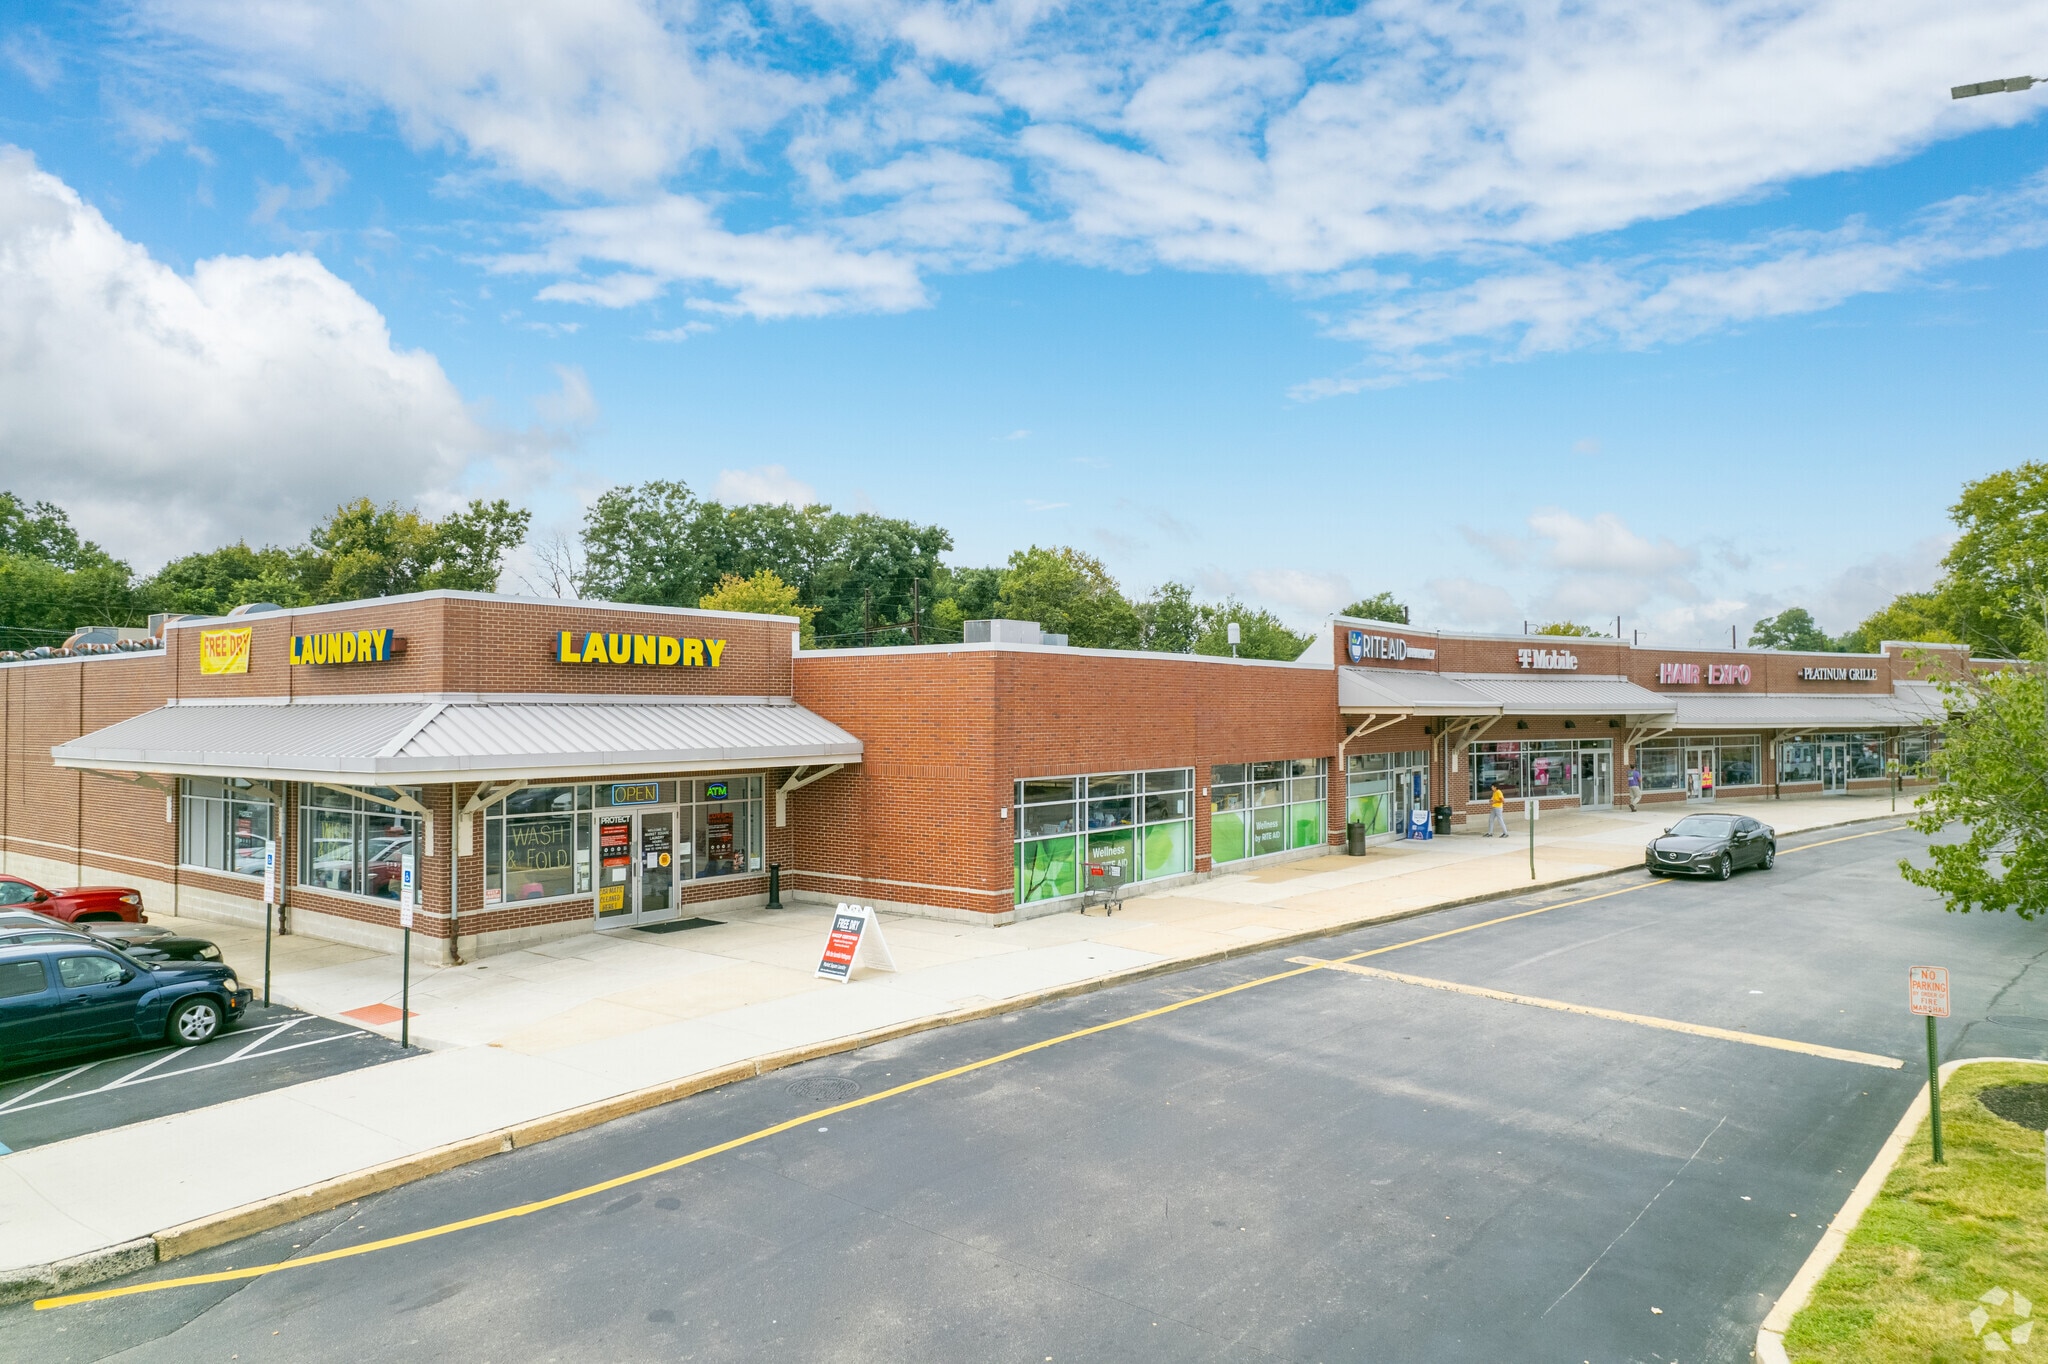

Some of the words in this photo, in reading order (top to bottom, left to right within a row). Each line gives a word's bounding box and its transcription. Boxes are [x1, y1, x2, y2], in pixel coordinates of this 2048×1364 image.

[204, 635, 227, 657] FREE
[230, 633, 250, 656] DRY
[289, 628, 392, 665] LAUNDRY
[558, 631, 727, 667] LAUNDRY
[1660, 663, 1700, 684] HAIR
[1708, 664, 1751, 686] EXPO
[1804, 667, 1847, 680] PLATINUM
[1849, 668, 1877, 681] GRILLE
[615, 785, 655, 802] OPEN
[707, 786, 727, 797] ATM
[601, 815, 630, 824] PROTECT
[1255, 821, 1278, 830] Wellness
[512, 824, 563, 846] WASH
[1262, 832, 1272, 840] RITE
[1092, 846, 1125, 859] Wellness
[507, 850, 517, 869] &
[527, 848, 567, 871] FOLD
[1921, 971, 1936, 980] NO
[1912, 980, 1946, 992] PARKING
[1913, 1004, 1946, 1013] MARSHAL
